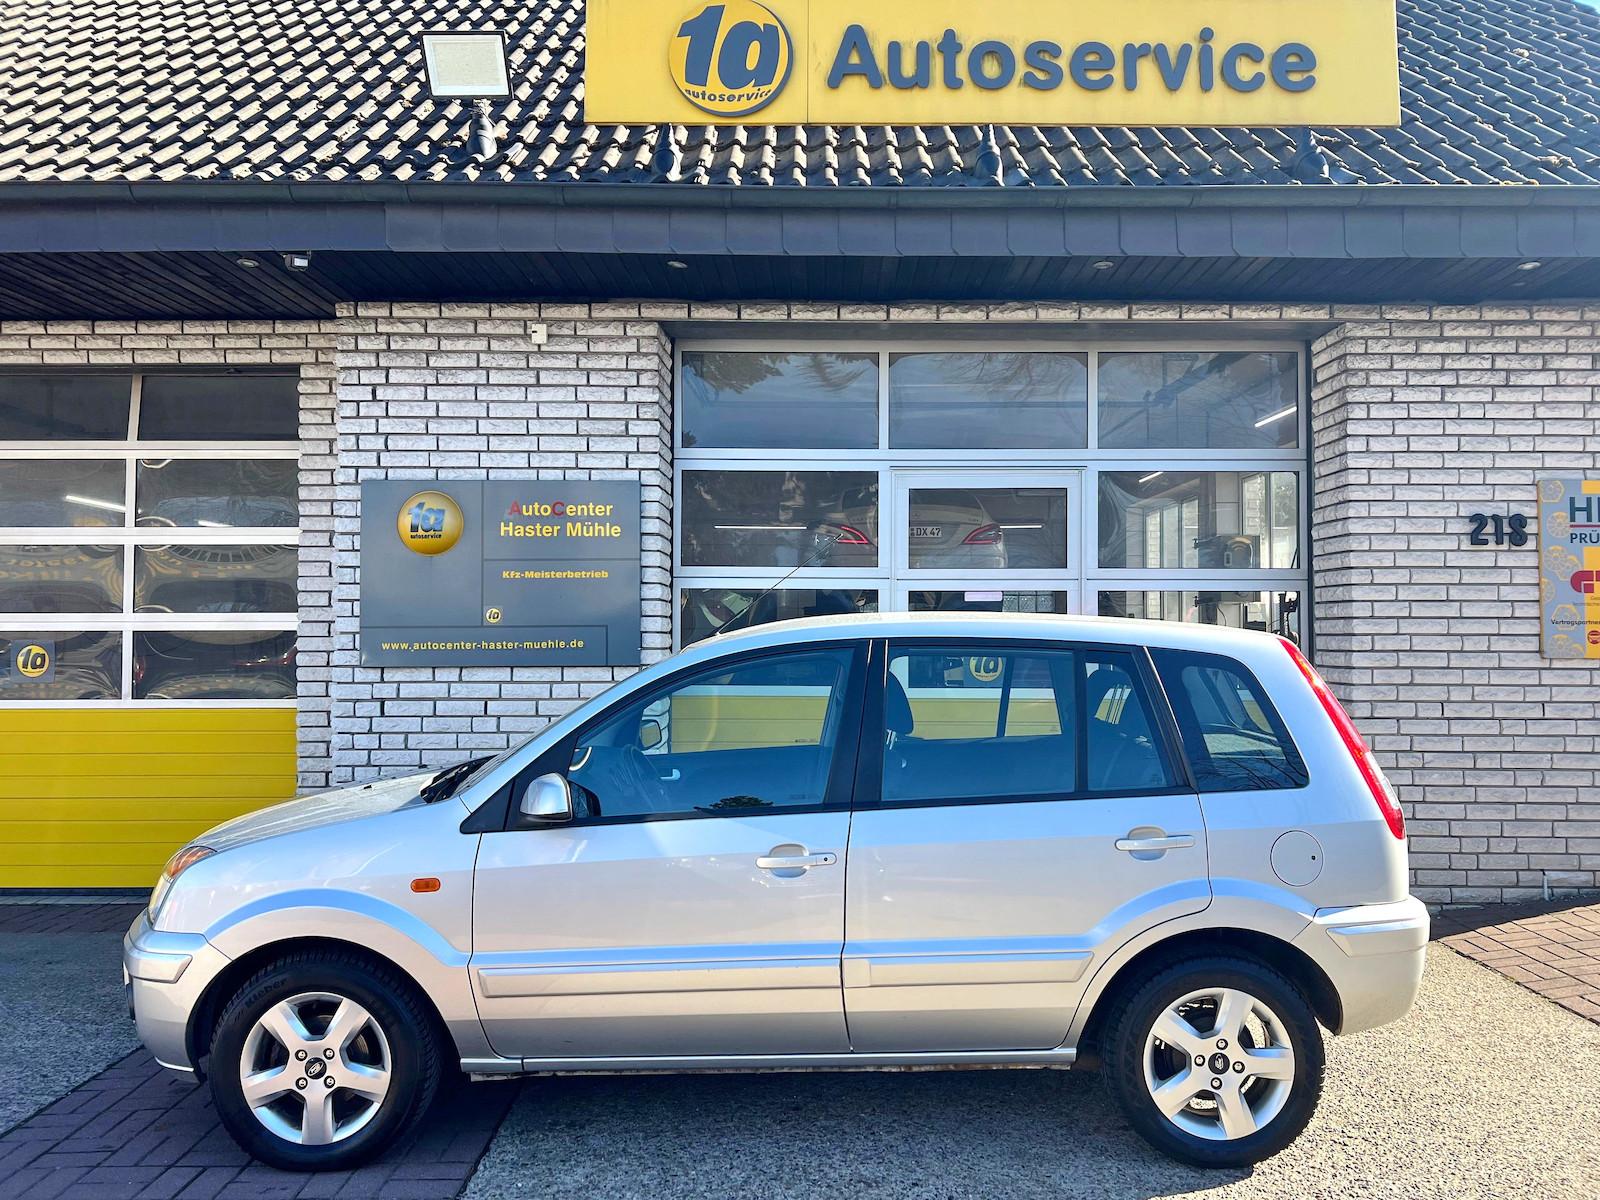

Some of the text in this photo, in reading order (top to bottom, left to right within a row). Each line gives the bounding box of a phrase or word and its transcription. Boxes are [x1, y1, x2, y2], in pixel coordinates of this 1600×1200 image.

[677, 5, 780, 90] 1a
[827, 24, 1317, 92] Autoservice
[684, 87, 773, 103] autoservice
[408, 502, 445, 532] 1a
[508, 501, 614, 517] AutoCenter
[500, 522, 621, 537] Haster Mühle
[1469, 513, 1528, 546] 218
[502, 570, 609, 579] Kfz-Meisterbetrieb
[381, 639, 585, 651] www.autocenter-haster-muehle.de
